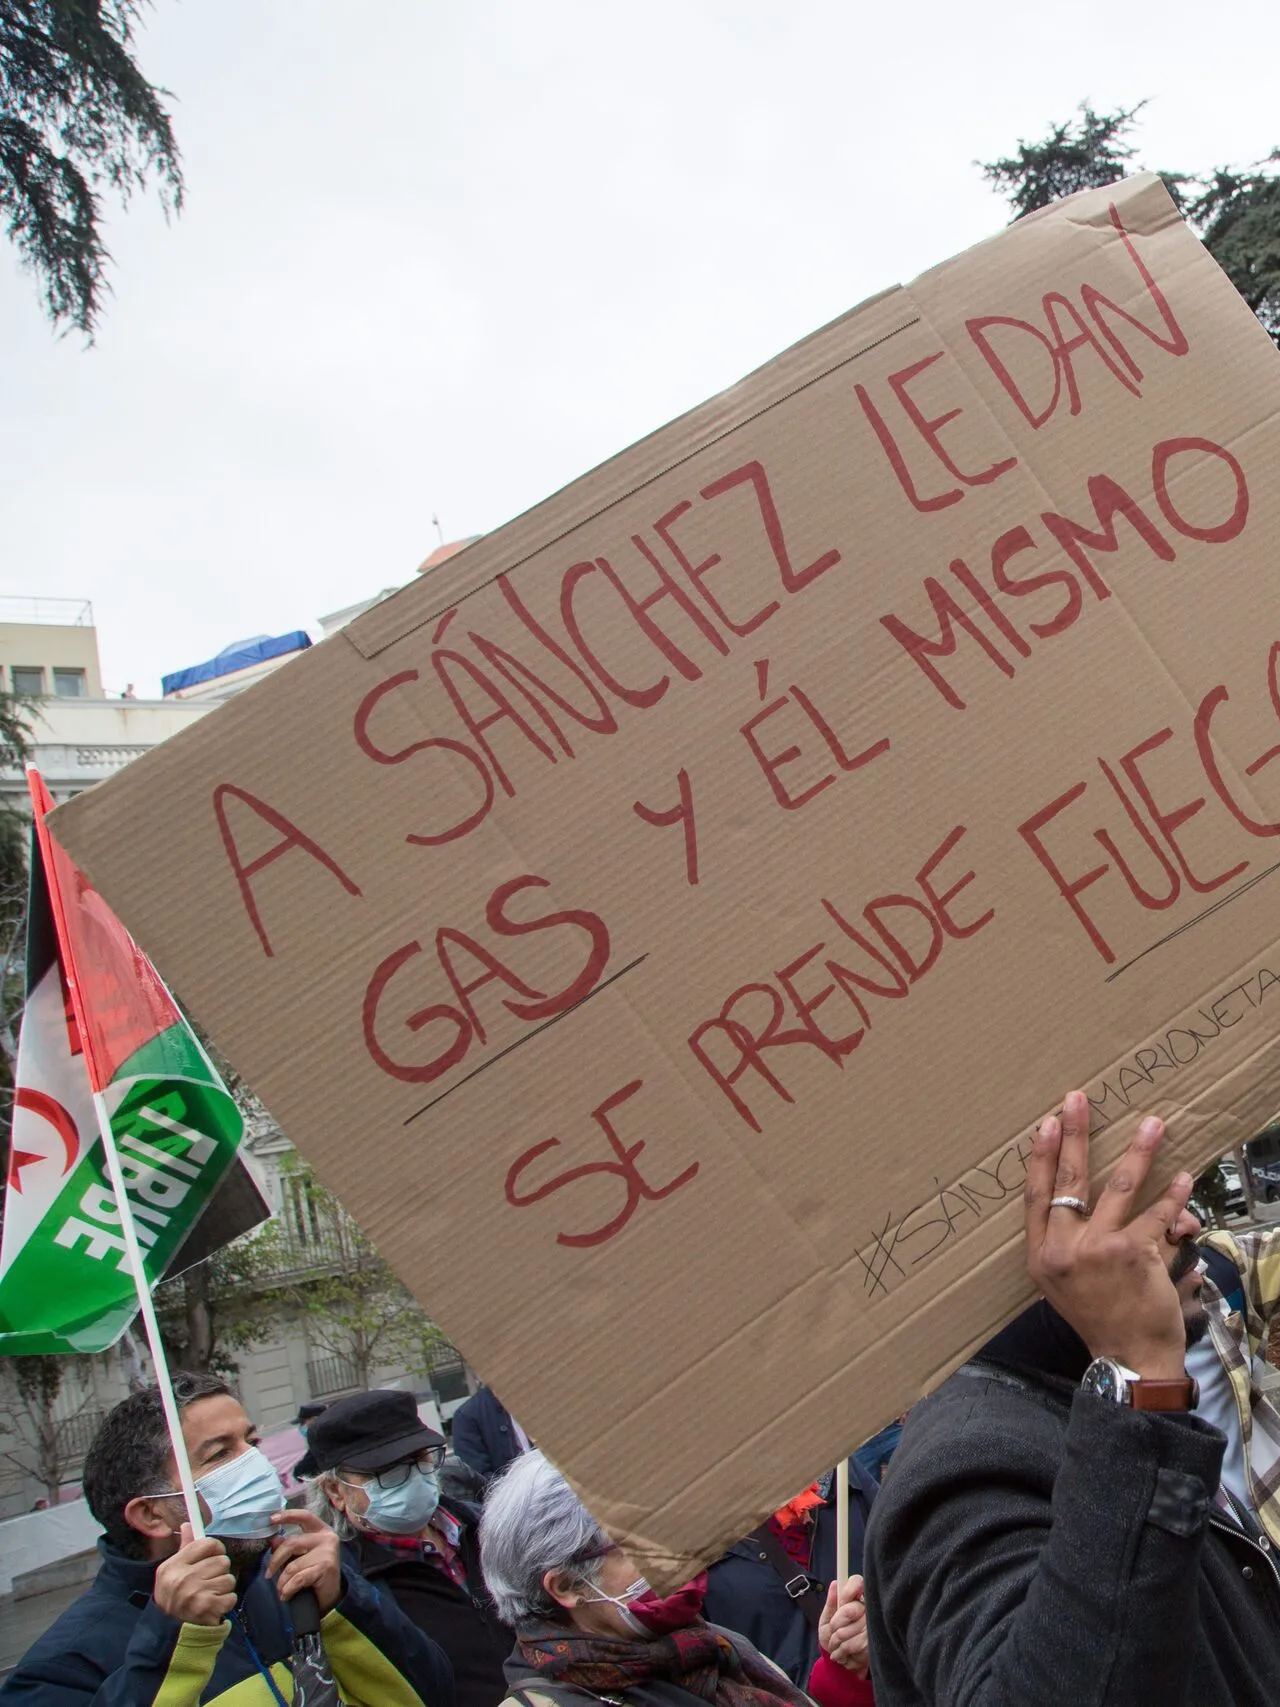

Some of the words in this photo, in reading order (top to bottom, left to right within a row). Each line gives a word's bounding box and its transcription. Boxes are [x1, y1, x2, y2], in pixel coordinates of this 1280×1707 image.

[212, 782, 363, 958] A
[354, 460, 842, 847] SÁNCHEZ
[854, 351, 1018, 513] LE
[964, 202, 1190, 429] DAN
[362, 874, 611, 1083] GAS
[632, 767, 699, 885] Y
[739, 659, 890, 810] ÉL
[879, 436, 1250, 710] MISMO
[504, 1079, 699, 1249] SE
[687, 825, 995, 1132] PRENDE
